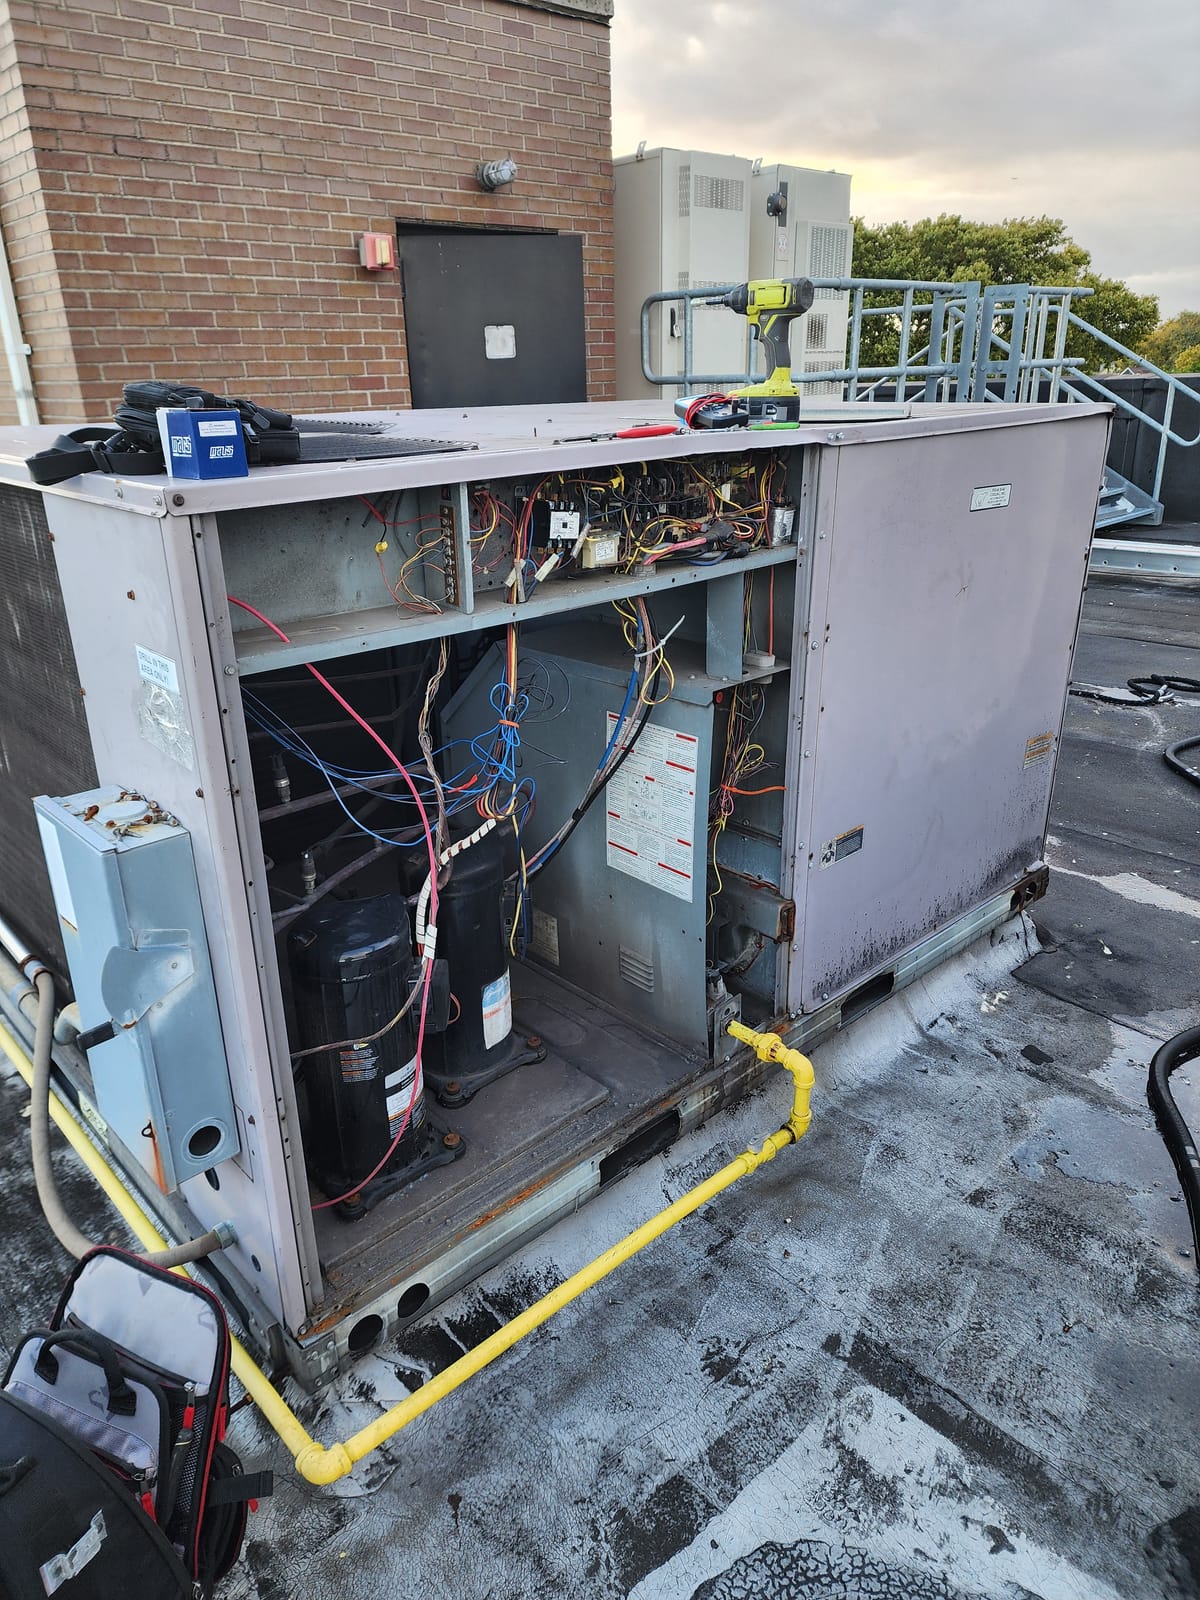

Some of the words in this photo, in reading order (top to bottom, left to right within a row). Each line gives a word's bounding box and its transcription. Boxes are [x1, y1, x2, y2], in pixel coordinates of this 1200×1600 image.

[138, 650, 153, 665] DRILL
[158, 660, 169, 673] THIS
[141, 663, 153, 677] AREA
[154, 669, 168, 686] ONLY!
